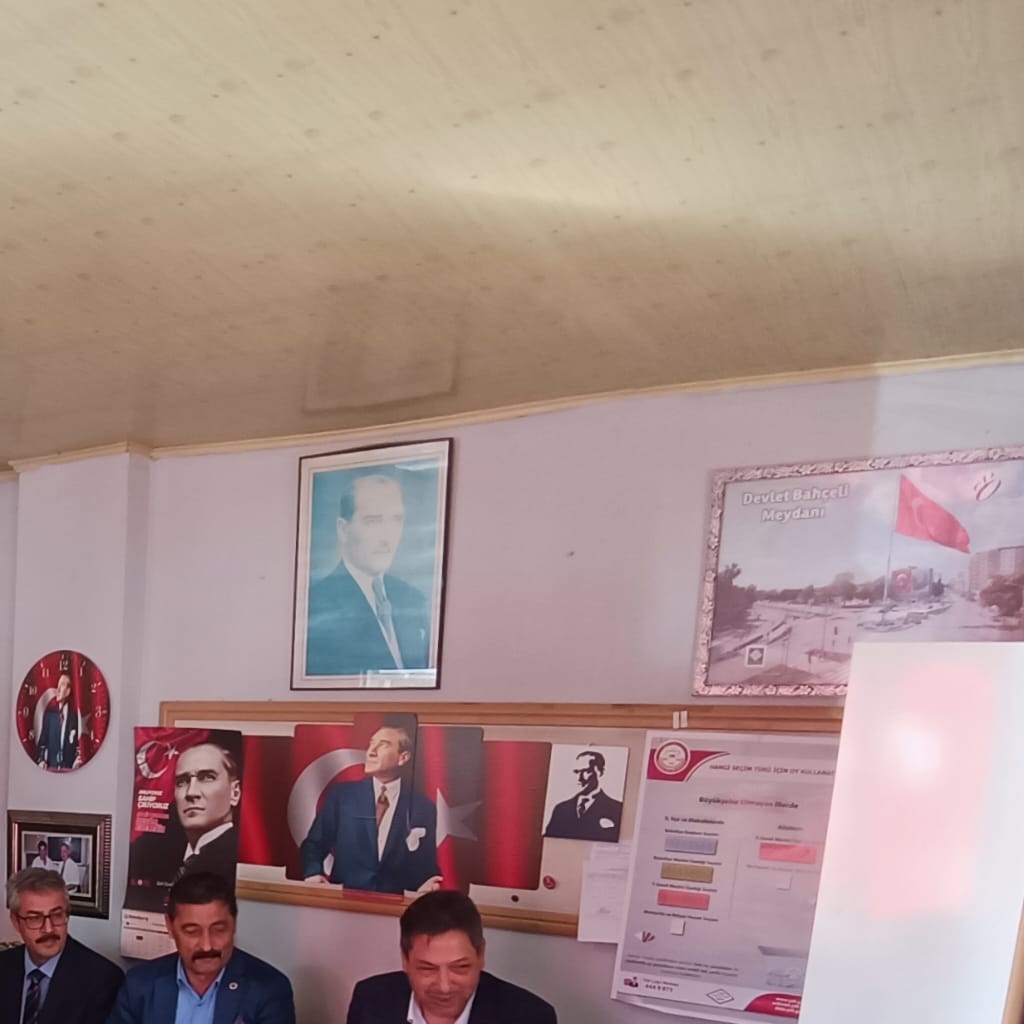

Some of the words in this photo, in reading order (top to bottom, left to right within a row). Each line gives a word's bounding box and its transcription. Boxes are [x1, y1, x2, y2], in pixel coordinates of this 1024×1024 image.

[743, 491, 790, 505] Devlet
[762, 507, 825, 523] Meydanı
[59, 659, 69, 671] 12
[42, 668, 50, 678] 11
[90, 683, 97, 693] 2
[95, 706, 102, 718] 3
